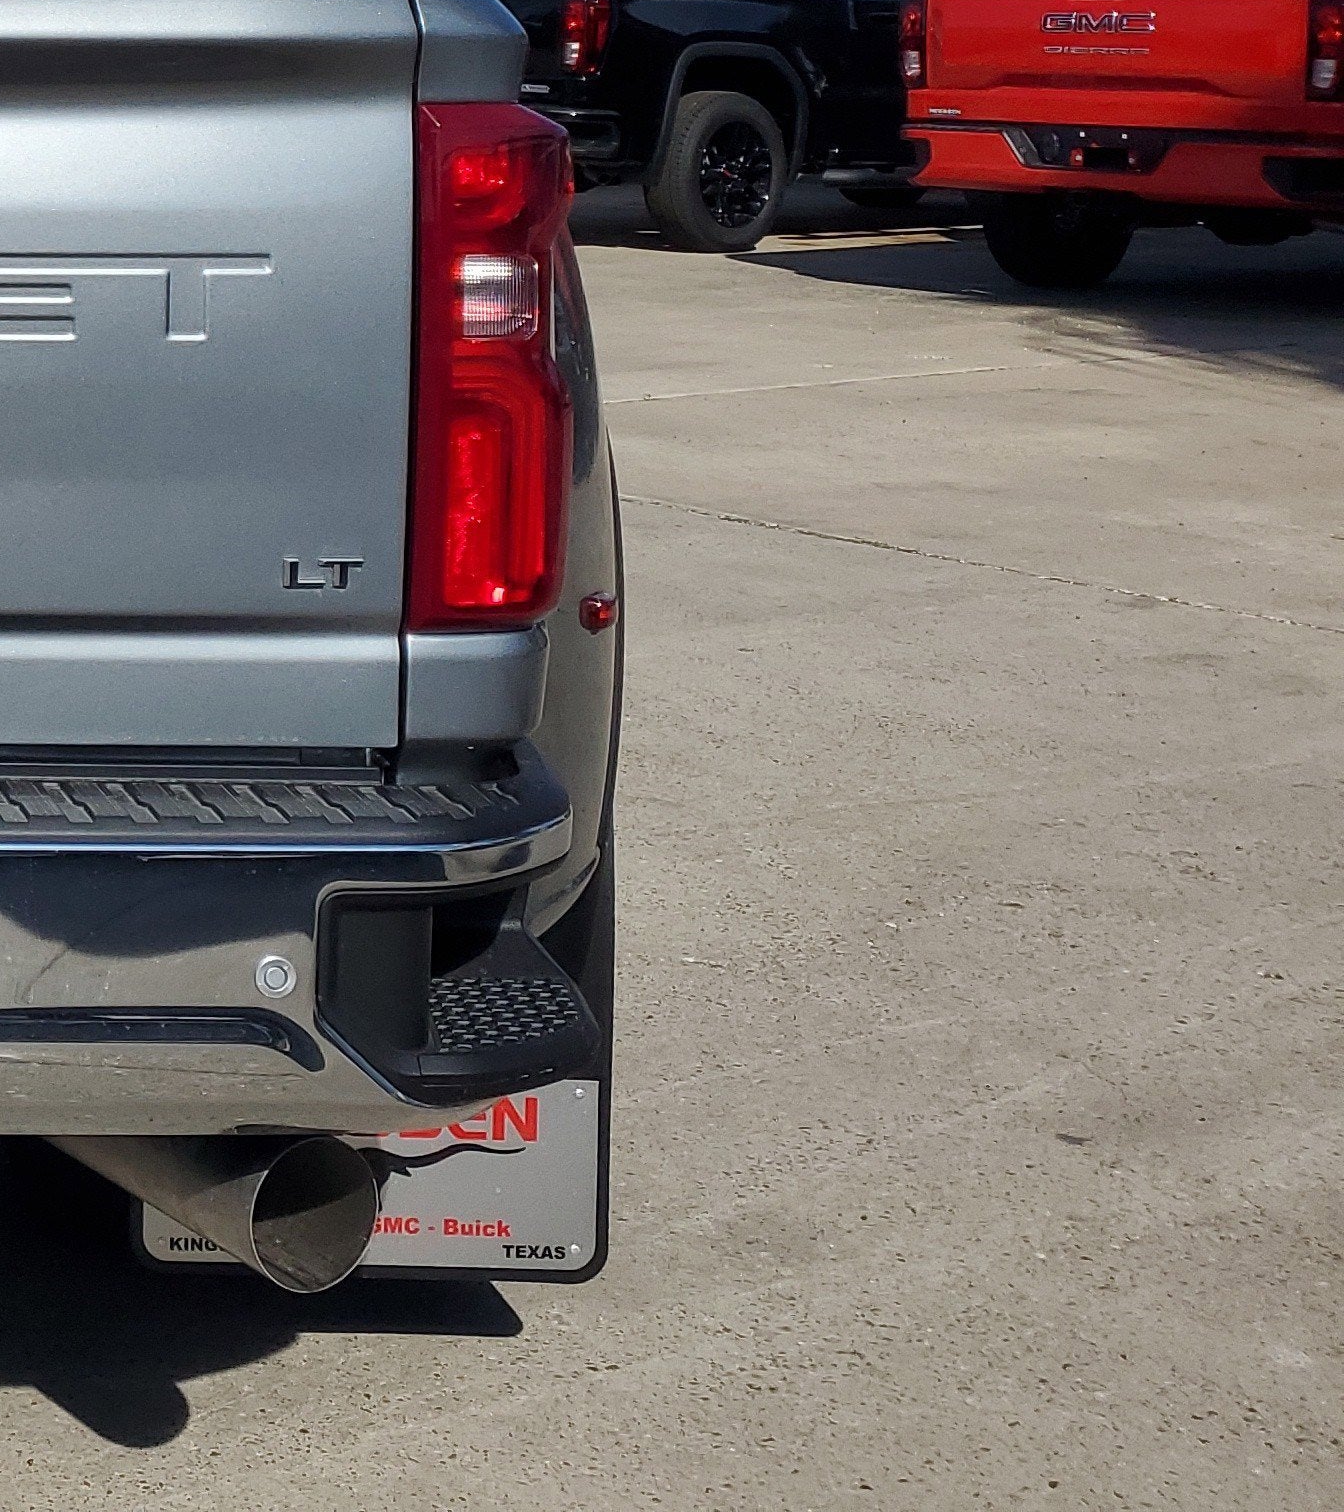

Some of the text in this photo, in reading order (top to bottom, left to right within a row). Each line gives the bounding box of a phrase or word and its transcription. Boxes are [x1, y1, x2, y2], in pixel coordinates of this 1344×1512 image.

[1042, 10, 1157, 34] GMC
[282, 557, 365, 590] LT
[443, 1218, 512, 1237] Buick
[502, 1244, 567, 1260] TEXAS
